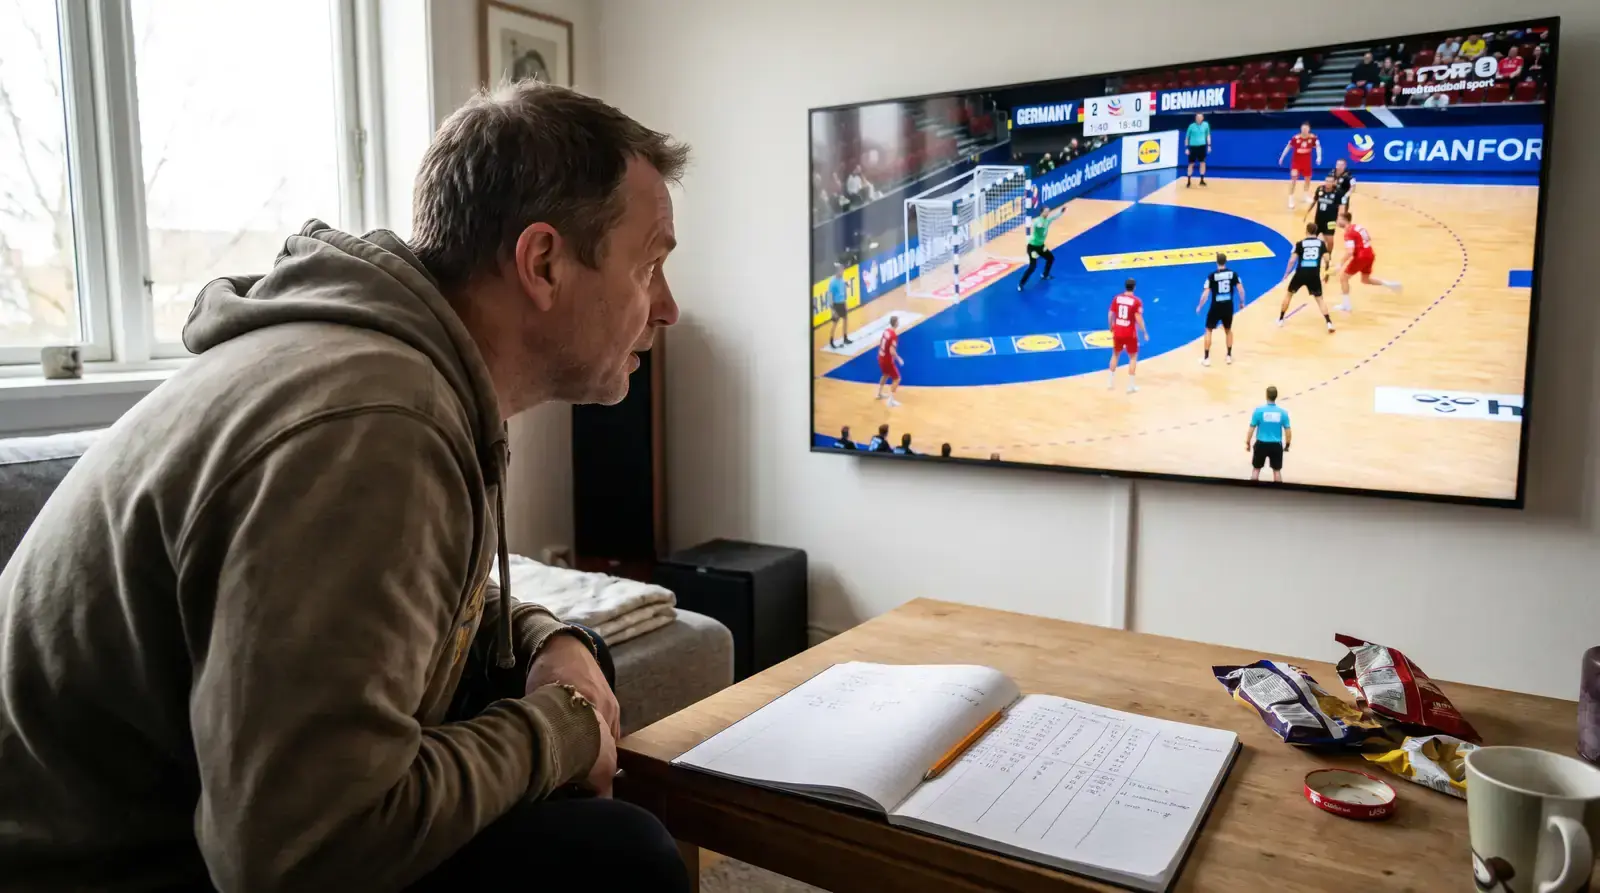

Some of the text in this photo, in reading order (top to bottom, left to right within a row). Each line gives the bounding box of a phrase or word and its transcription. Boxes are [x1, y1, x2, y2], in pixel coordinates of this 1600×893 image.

[1467, 79, 1494, 91] sport
[1017, 87, 1225, 125] GERMANY 2 0 DENMARK
